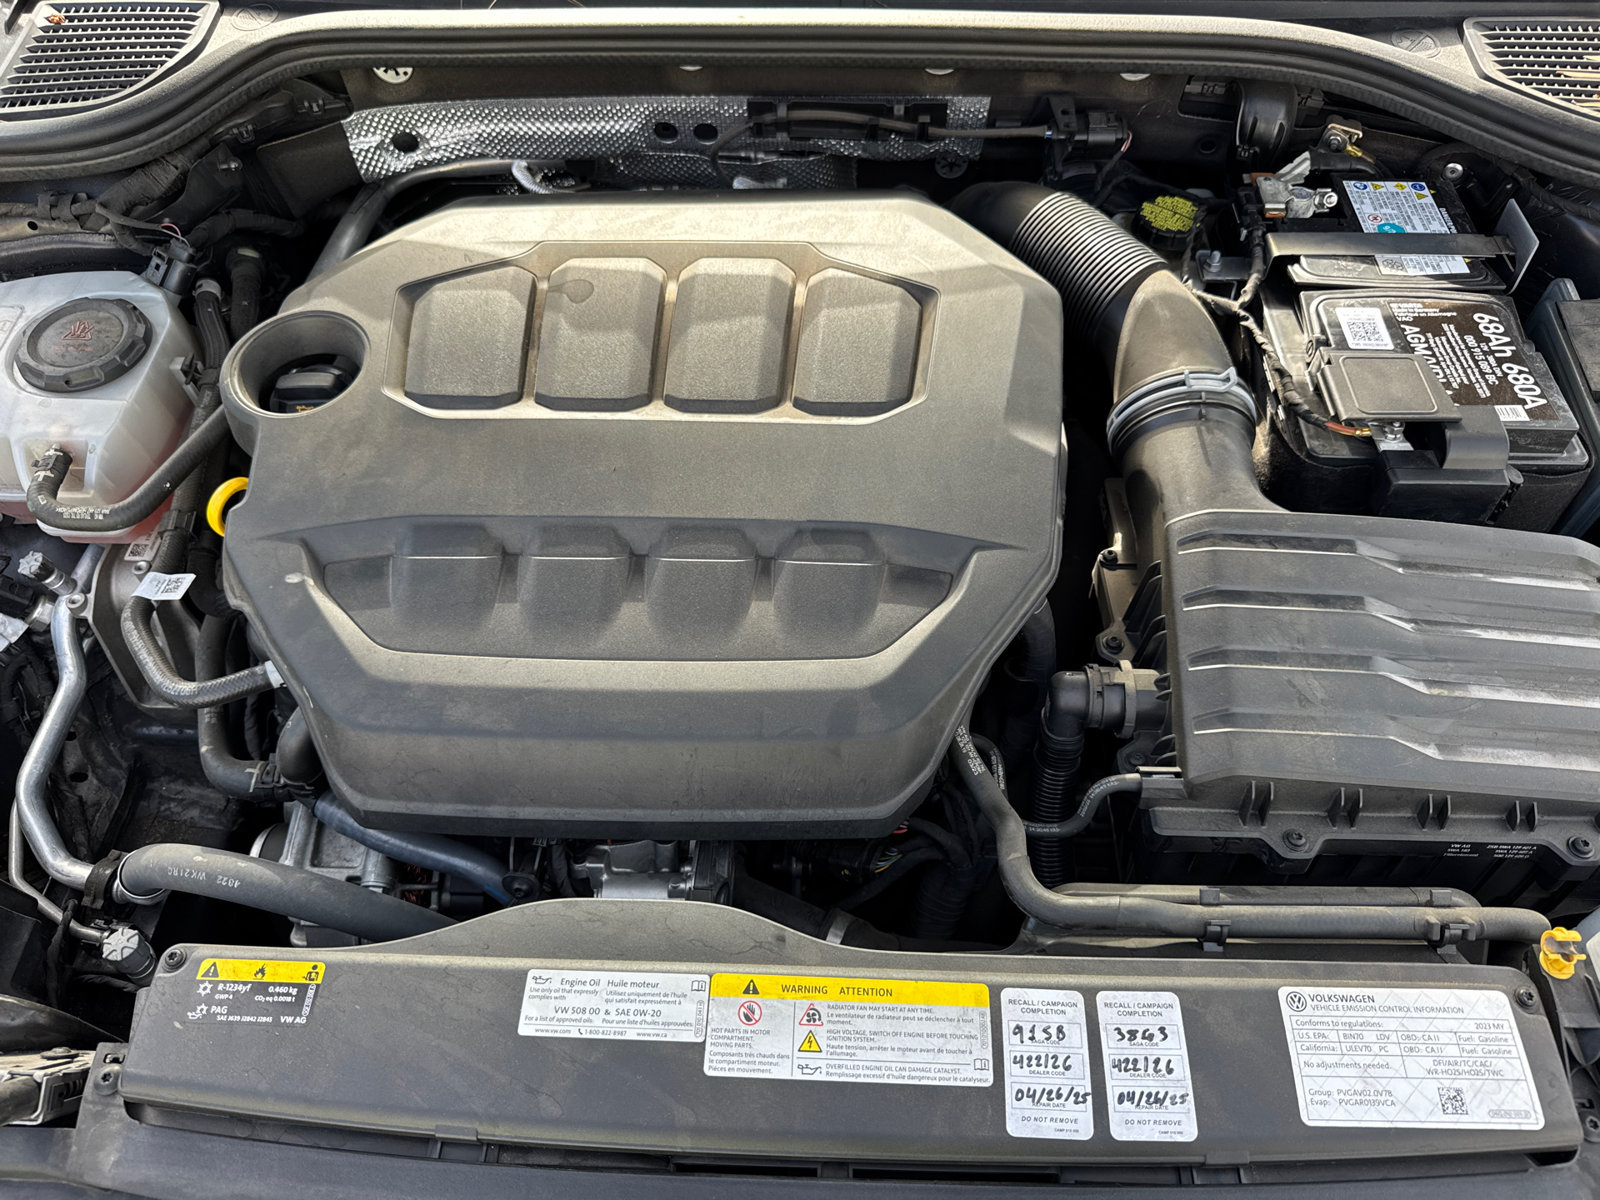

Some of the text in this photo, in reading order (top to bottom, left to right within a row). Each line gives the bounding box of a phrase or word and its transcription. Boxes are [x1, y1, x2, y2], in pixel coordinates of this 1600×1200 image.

[1464, 335, 1478, 348] 000
[1471, 348, 1486, 360] 915
[1485, 374, 1499, 385] BC
[1473, 313, 1548, 410] 68Ah 680A
[167, 866, 206, 880] WK21RC
[561, 978, 587, 988] Engine
[589, 979, 600, 987] Oil
[607, 980, 628, 988] Huile
[218, 983, 252, 994] R-1234yf
[289, 986, 298, 996] kg
[781, 984, 893, 997] WARNING ATTENTION
[1041, 1000, 1078, 1008] CAMPAIGN
[1308, 994, 1375, 1003] VOLKSWAGEN
[210, 1006, 228, 1014] PAG
[554, 1006, 570, 1014] VW
[588, 1007, 600, 1015] 00
[615, 1008, 631, 1016] SAE
[633, 1009, 662, 1017] 0W-20
[1021, 1007, 1066, 1015] COMPLETION
[1310, 1004, 1340, 1012] VEHICLE
[1414, 1006, 1464, 1014] INFORMATION
[1295, 1019, 1330, 1027] Conforms
[1474, 1022, 1491, 1030] 2023
[1492, 1022, 1504, 1030] MY
[1478, 1035, 1509, 1043] Gasoline
[1481, 1047, 1512, 1055] Gasoline
[1316, 1062, 1362, 1070] adjustments
[826, 1071, 862, 1079] Remplissage
[906, 1074, 938, 1082] dangereux
[1015, 1086, 1092, 1105] 04/26/25
[1117, 1090, 1190, 1106] 04/26/25
